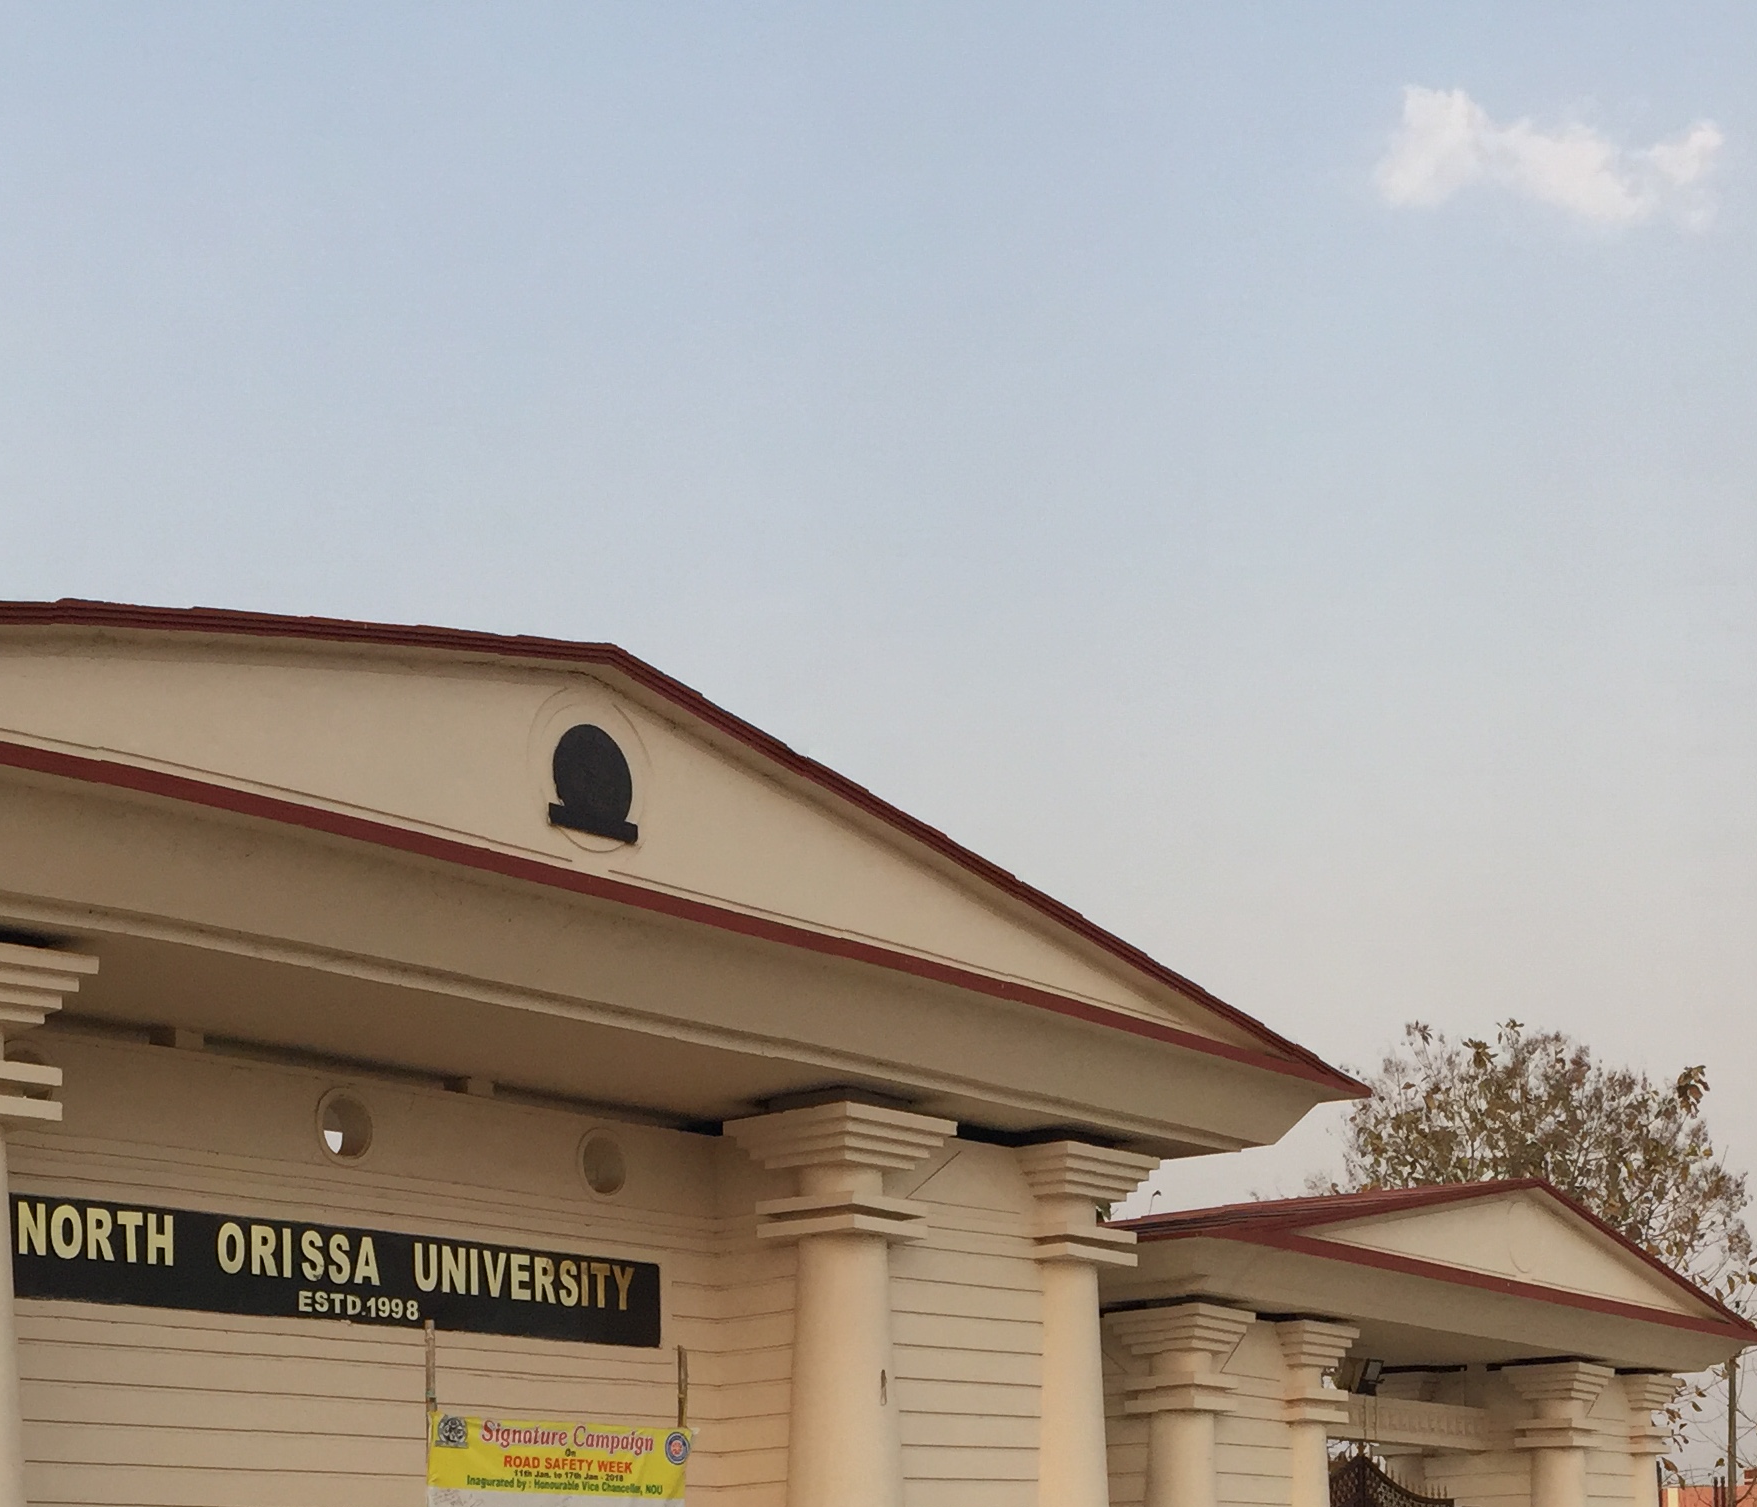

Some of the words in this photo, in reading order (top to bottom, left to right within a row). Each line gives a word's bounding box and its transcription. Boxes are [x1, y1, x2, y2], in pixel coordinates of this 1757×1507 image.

[17, 1201, 174, 1266] NORTH
[217, 1222, 380, 1286] ORISSA
[414, 1242, 635, 1311] UNIVERSITY
[481, 1419, 568, 1448] Signature
[573, 1425, 654, 1456] Campaign
[565, 1448, 576, 1457] On
[504, 1455, 540, 1469] ROAD
[544, 1457, 593, 1472] SAFETY
[597, 1460, 632, 1474] WEEK
[517, 1479, 527, 1491] by
[582, 1481, 599, 1491] Vice
